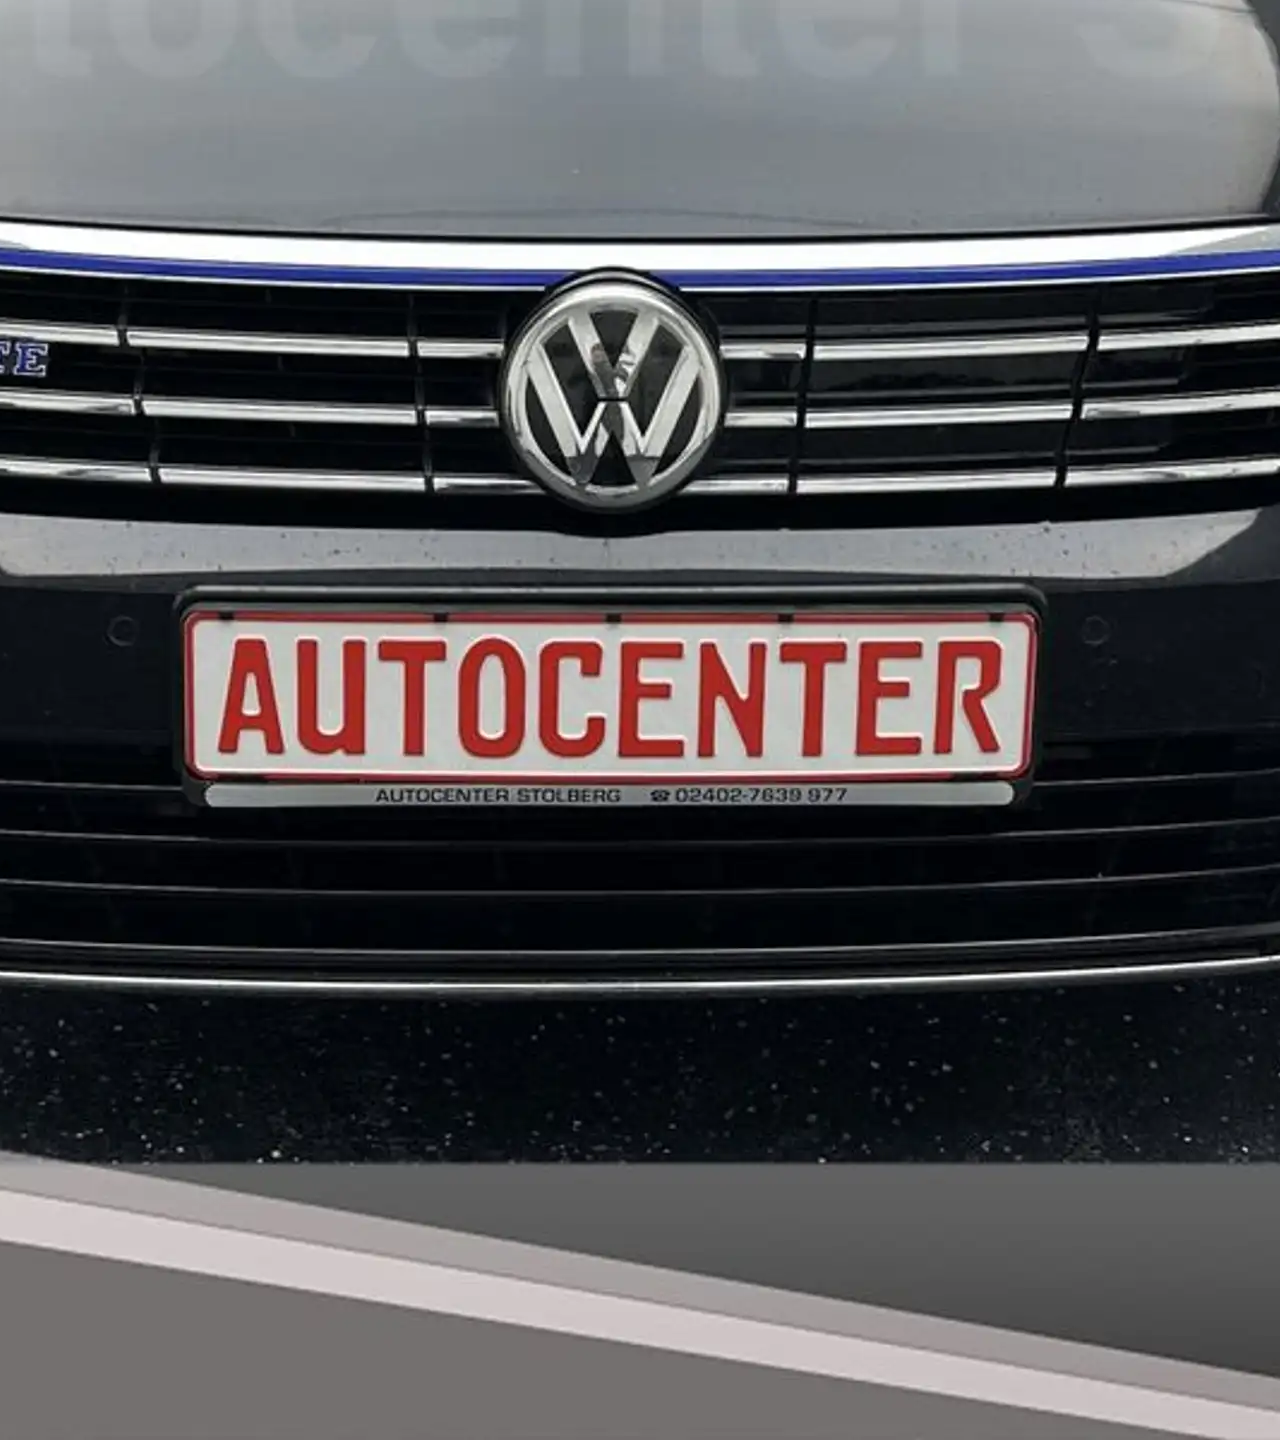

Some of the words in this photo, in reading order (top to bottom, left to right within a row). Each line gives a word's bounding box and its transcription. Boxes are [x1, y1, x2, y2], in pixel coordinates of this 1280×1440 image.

[520, 308, 704, 490] VW
[218, 638, 1002, 757] AUTOCENTER
[375, 787, 510, 803] AUTOCENTER
[516, 787, 622, 803] STOLBERG
[674, 787, 802, 803] 02402-7639
[807, 787, 848, 803] 977
